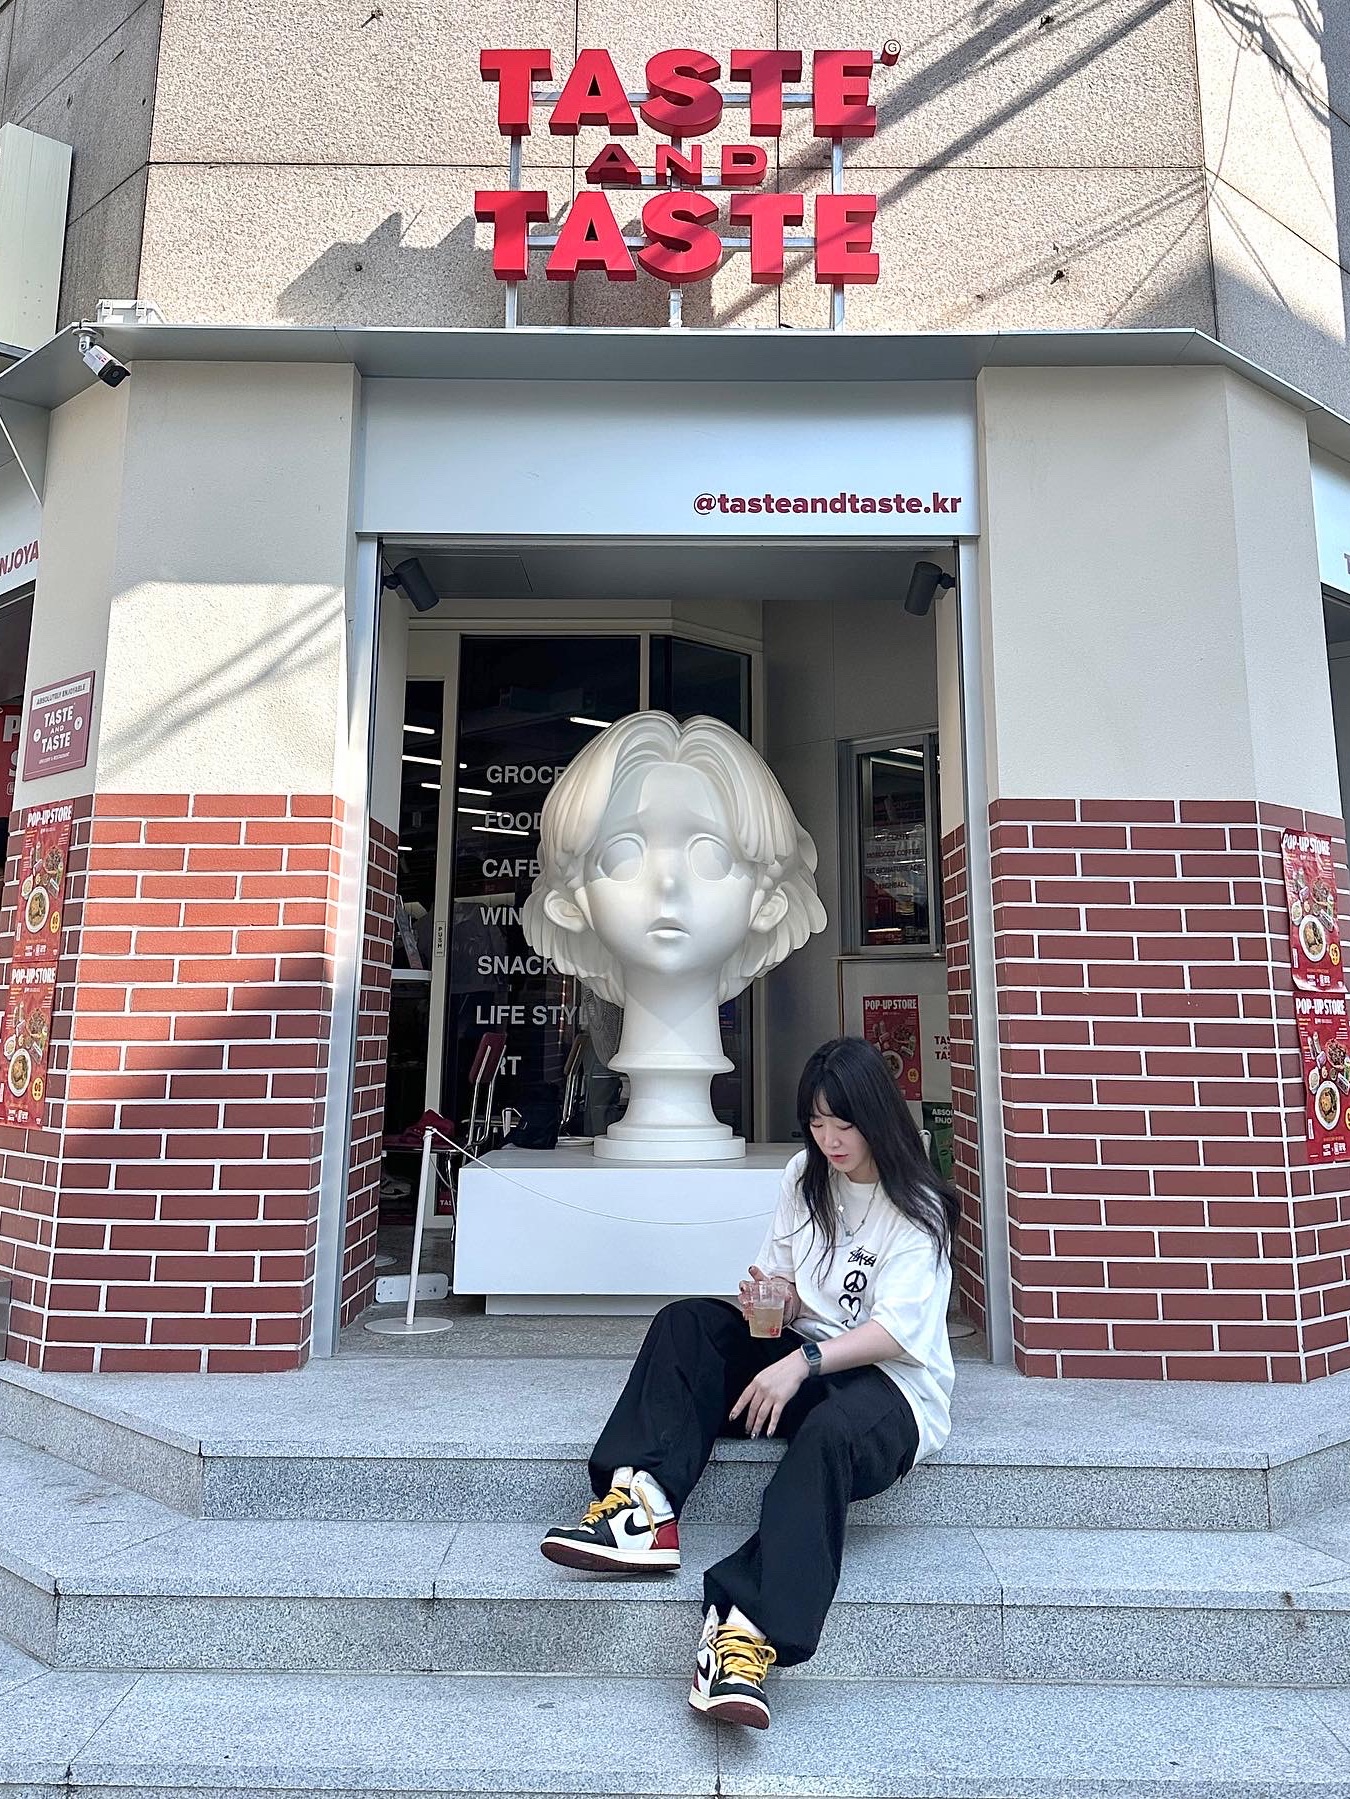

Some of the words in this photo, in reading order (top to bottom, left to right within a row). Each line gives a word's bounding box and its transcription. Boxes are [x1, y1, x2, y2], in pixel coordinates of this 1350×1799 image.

[480, 48, 877, 137] TASTE
[585, 144, 768, 185] AND
[475, 190, 880, 284] TASTE
[693, 492, 962, 515] @tasteandtaste.kr
[44, 705, 74, 727] TASTE
[50, 725, 64, 734] AND
[41, 731, 71, 753] TASTE
[482, 859, 540, 878] CAFE
[480, 907, 523, 925] WIN
[477, 955, 559, 975] SNACK
[476, 1005, 525, 1025] LIFE
